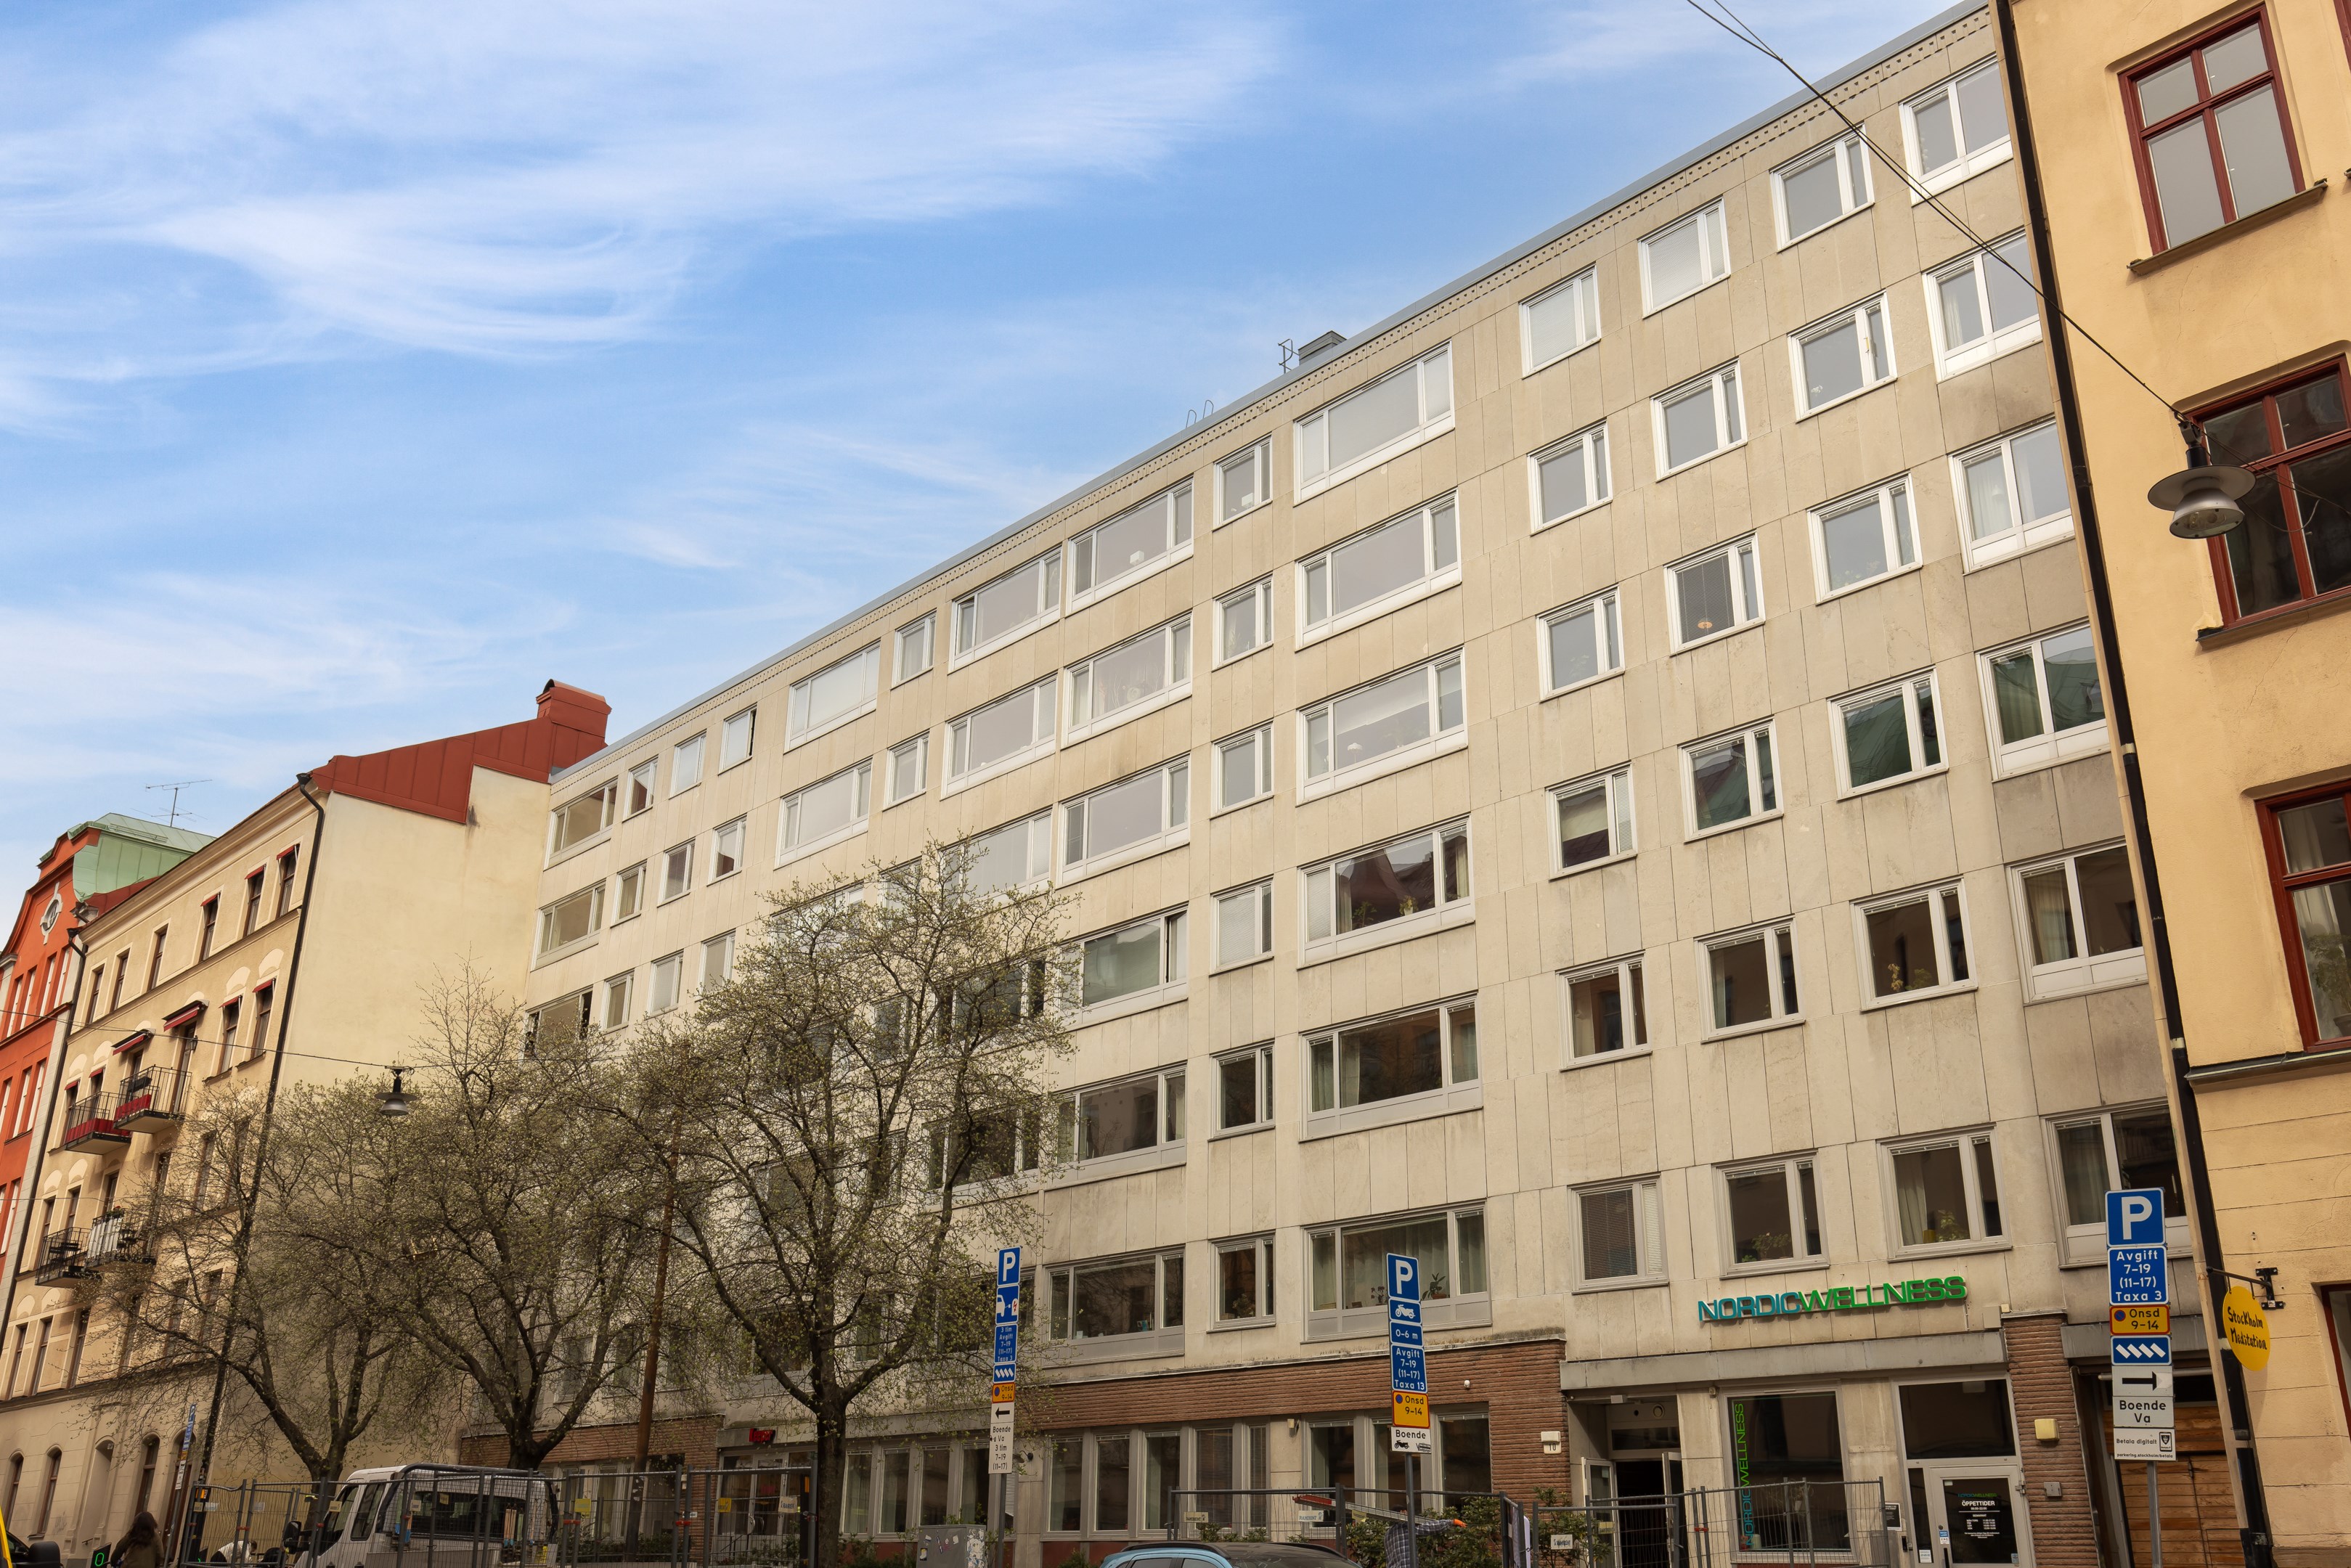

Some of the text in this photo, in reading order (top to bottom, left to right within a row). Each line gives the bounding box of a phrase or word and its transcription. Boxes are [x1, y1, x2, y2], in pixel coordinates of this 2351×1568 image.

[2121, 1196, 2153, 1240] P
[2116, 1249, 2158, 1263] Avgift
[1002, 1251, 1016, 1282] P
[2123, 1264, 2151, 1274] 7-19
[1395, 1259, 1413, 1294] P
[2119, 1275, 2157, 1289] (11-17)
[2115, 1290, 2162, 1302] Taxa 3
[2129, 1308, 2160, 1318] Onsd
[2131, 1319, 2159, 1330] 9-14
[999, 1333, 1013, 1342] Avgift
[1395, 1328, 1409, 1339] 0-6
[2230, 1327, 2267, 1350] Meditation
[1396, 1347, 1420, 1359] Avgift
[1400, 1359, 1416, 1368] 7-19
[1398, 1368, 1420, 1380] (11-17)
[1394, 1379, 1425, 1390] Taxa 13
[1405, 1395, 1424, 1405] Onsd
[2119, 1400, 2166, 1410] Boende
[1405, 1406, 1423, 1416] 9-14
[2134, 1413, 2151, 1423] Va
[1395, 1429, 1426, 1439] Boende
